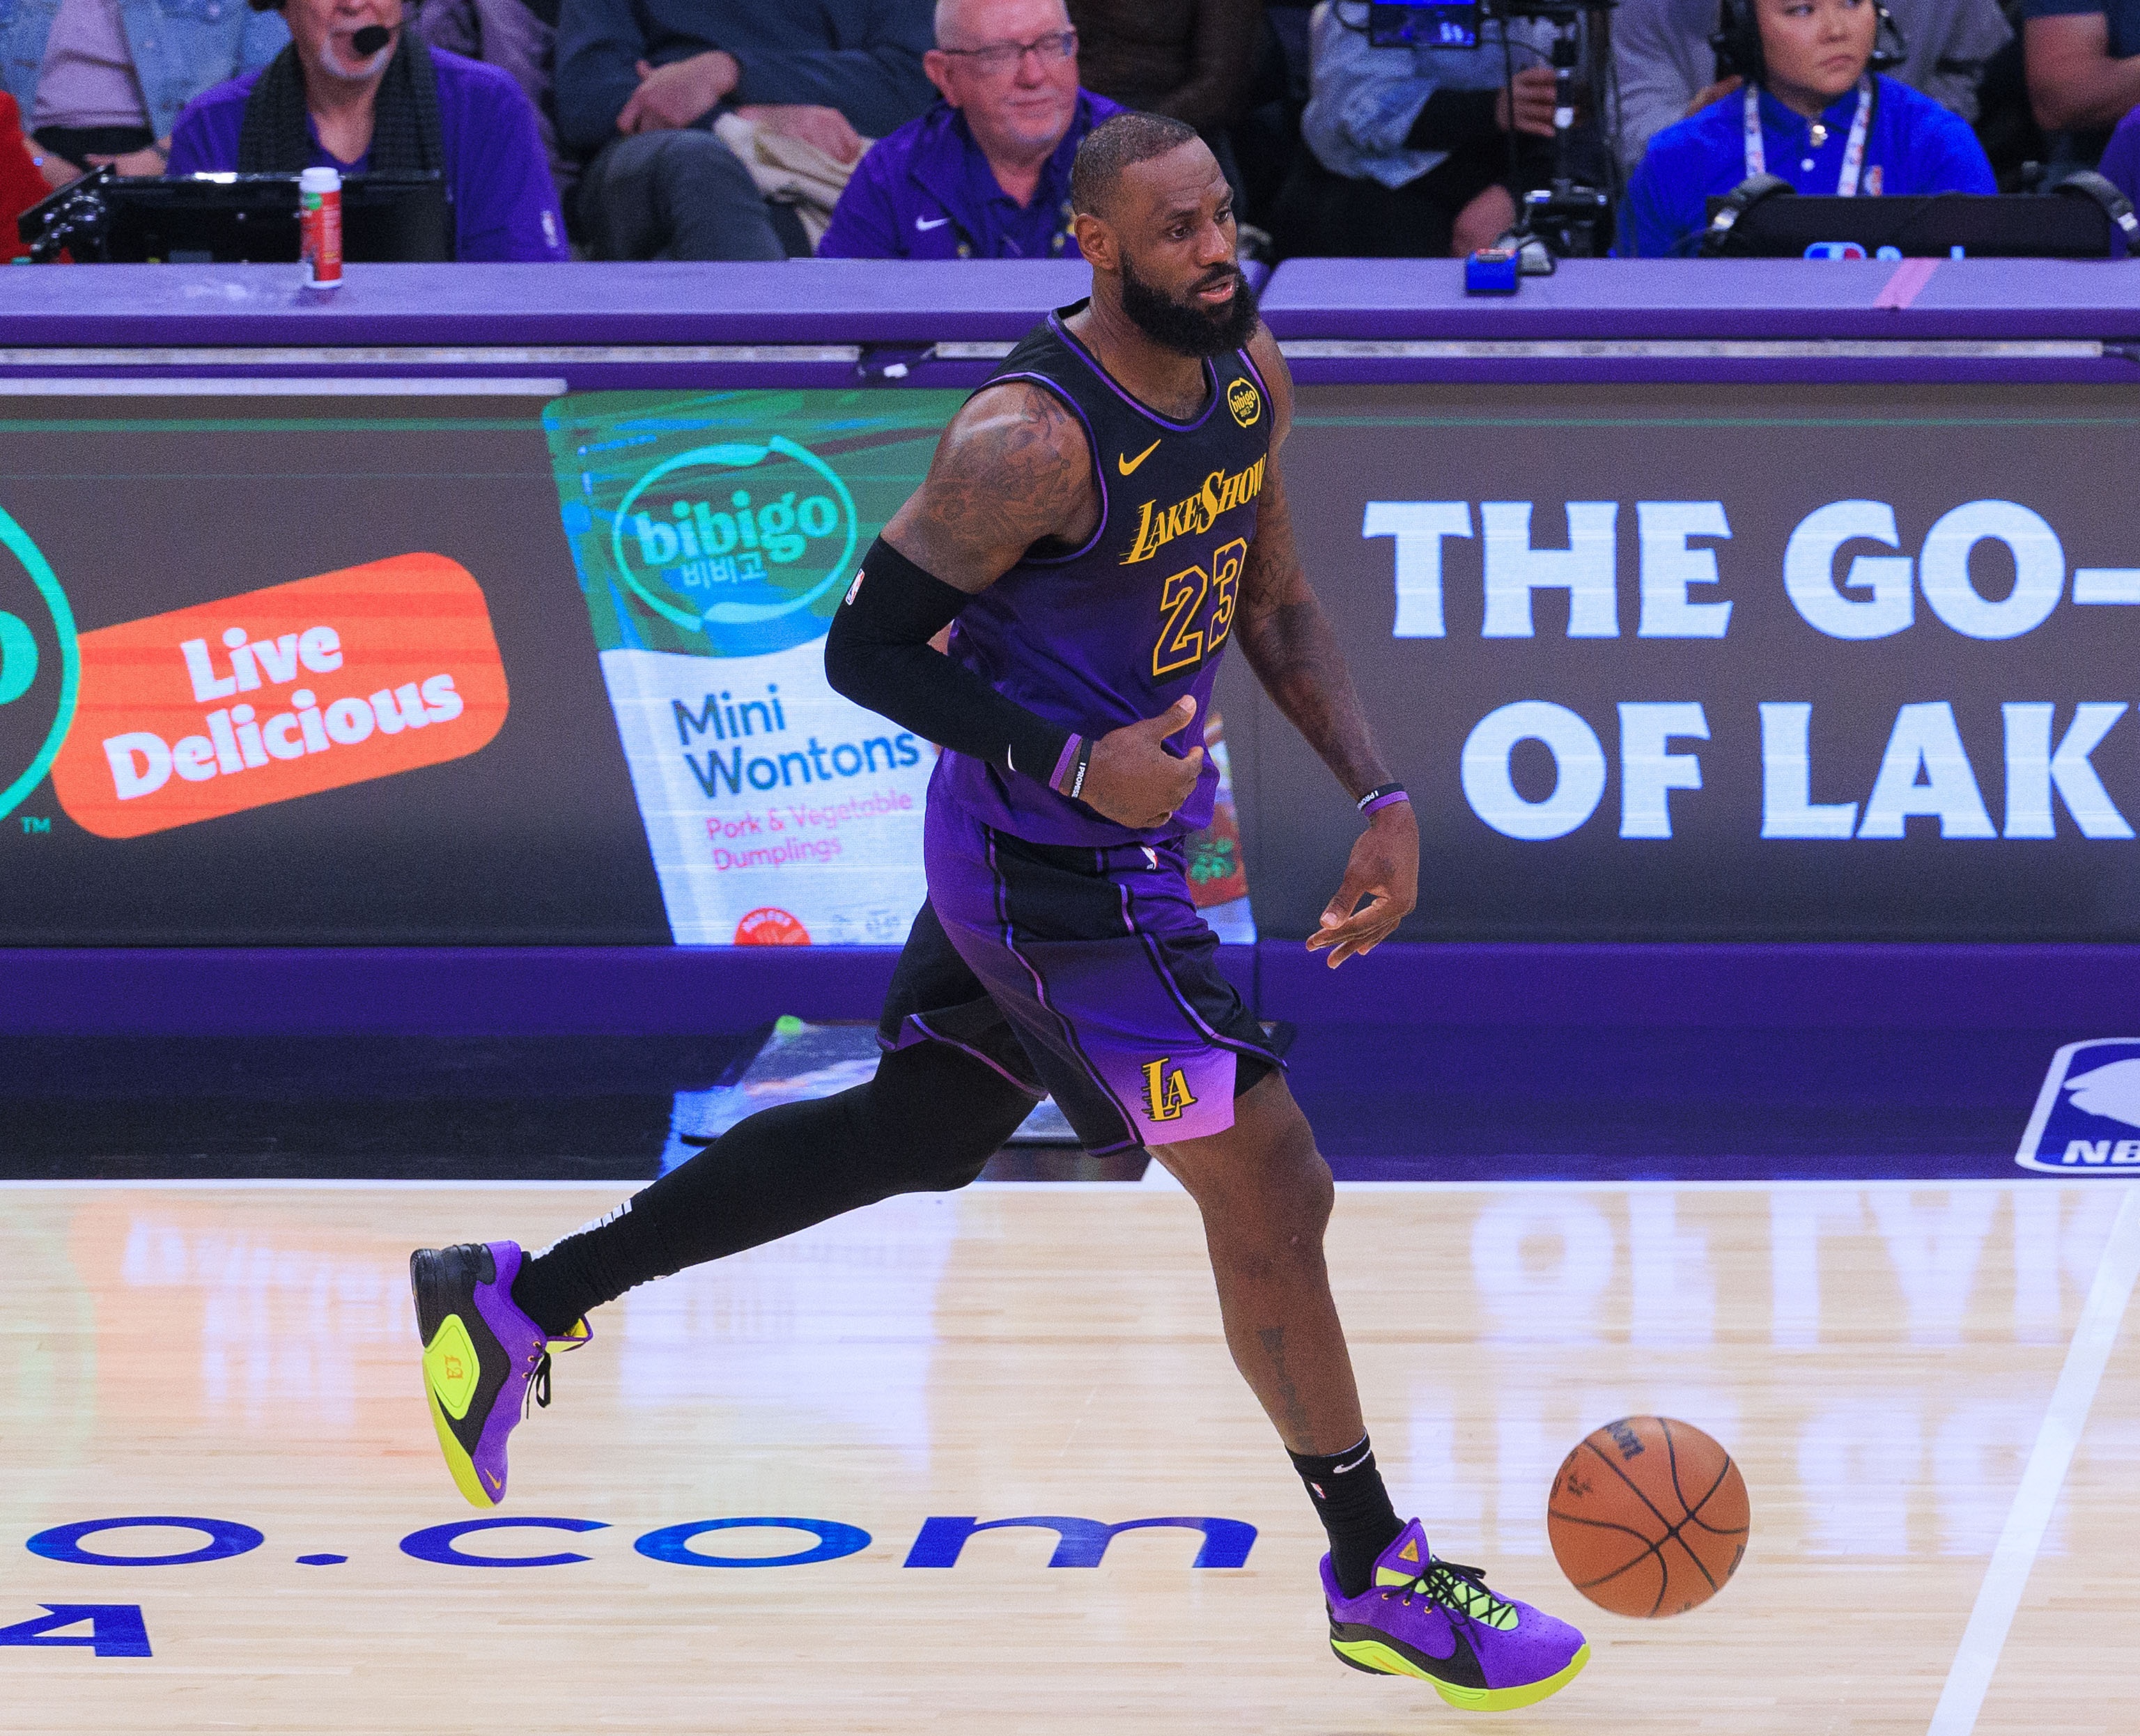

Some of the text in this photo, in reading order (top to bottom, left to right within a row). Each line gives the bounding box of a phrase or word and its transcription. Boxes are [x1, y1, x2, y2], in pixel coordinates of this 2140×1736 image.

[1231, 391, 1256, 412] bibigo
[635, 490, 839, 564] bibigo
[1363, 500, 1733, 640] THE
[1153, 537, 1248, 676] 23
[180, 626, 343, 703] Live
[102, 674, 464, 800] Delicious
[671, 683, 786, 746] Mini
[684, 732, 921, 798] Wontons
[1460, 699, 2137, 842] OF LAK
[22, 816, 51, 833] TM
[706, 787, 913, 840] Pork & Vegetable
[713, 835, 842, 871] Dumplings
[1141, 1057, 1197, 1122] LA
